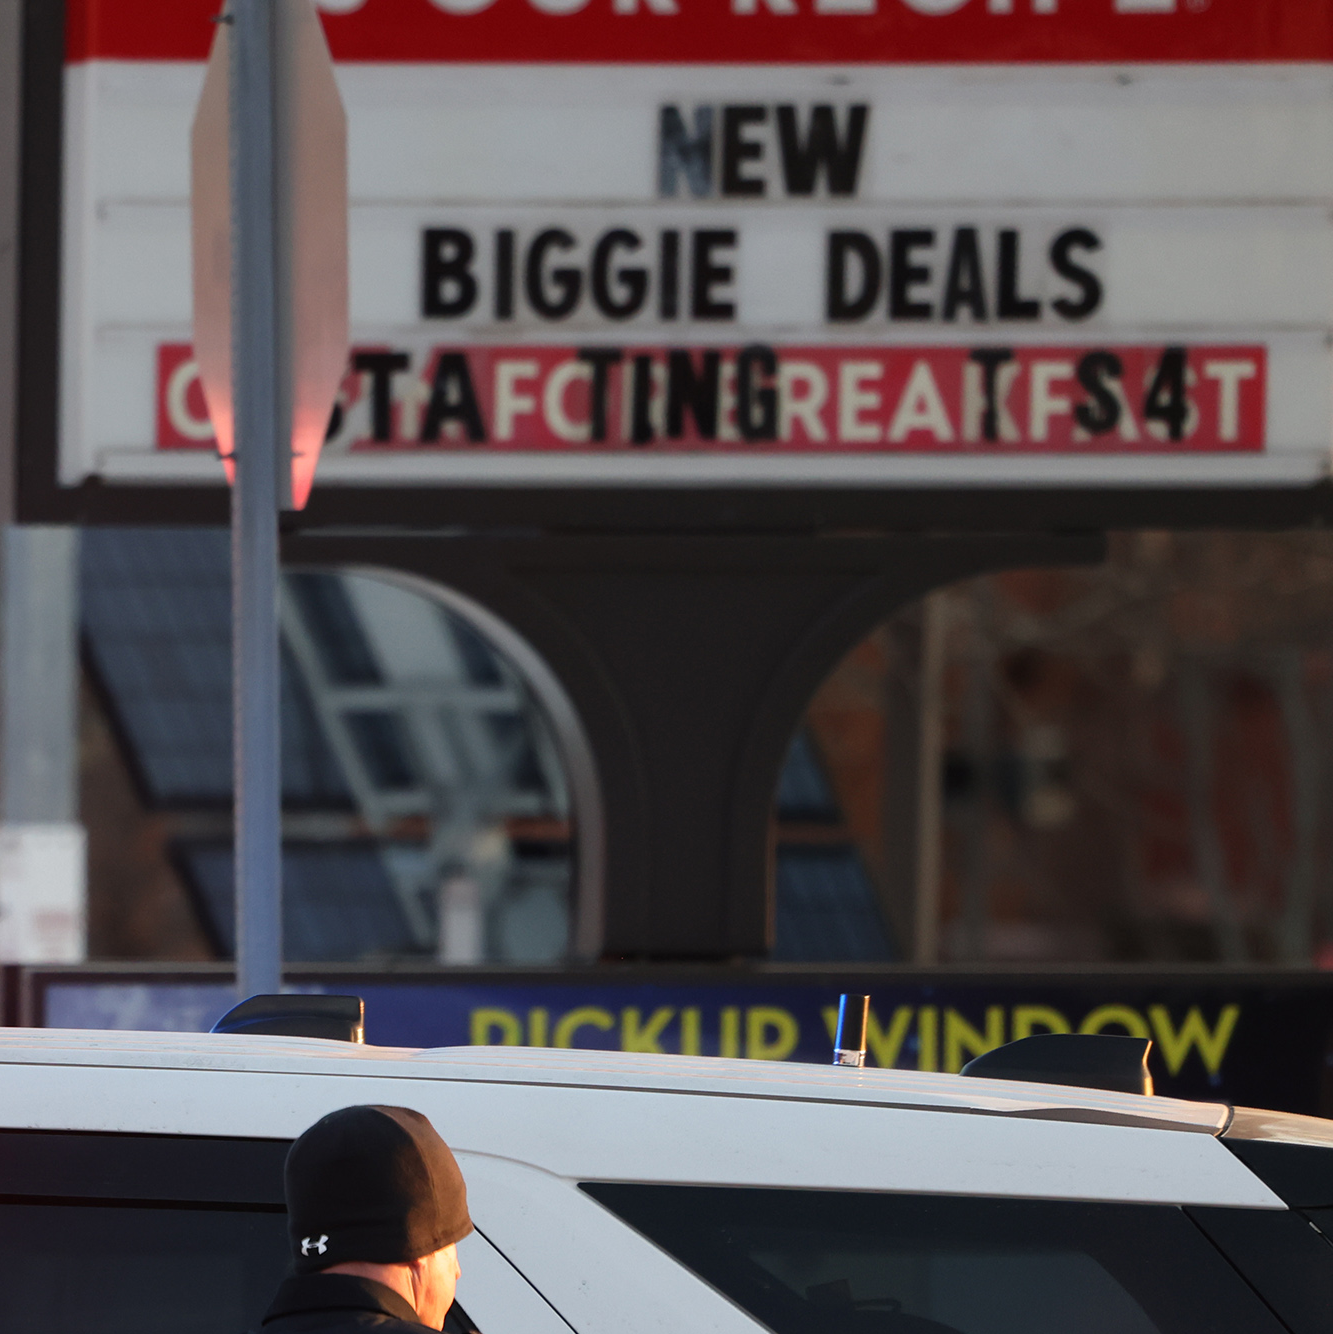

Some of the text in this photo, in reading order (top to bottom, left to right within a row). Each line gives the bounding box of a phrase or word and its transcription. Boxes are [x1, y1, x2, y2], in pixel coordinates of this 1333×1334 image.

[659, 103, 870, 199] NEW
[420, 226, 1103, 323] BIGGIE DEALS
